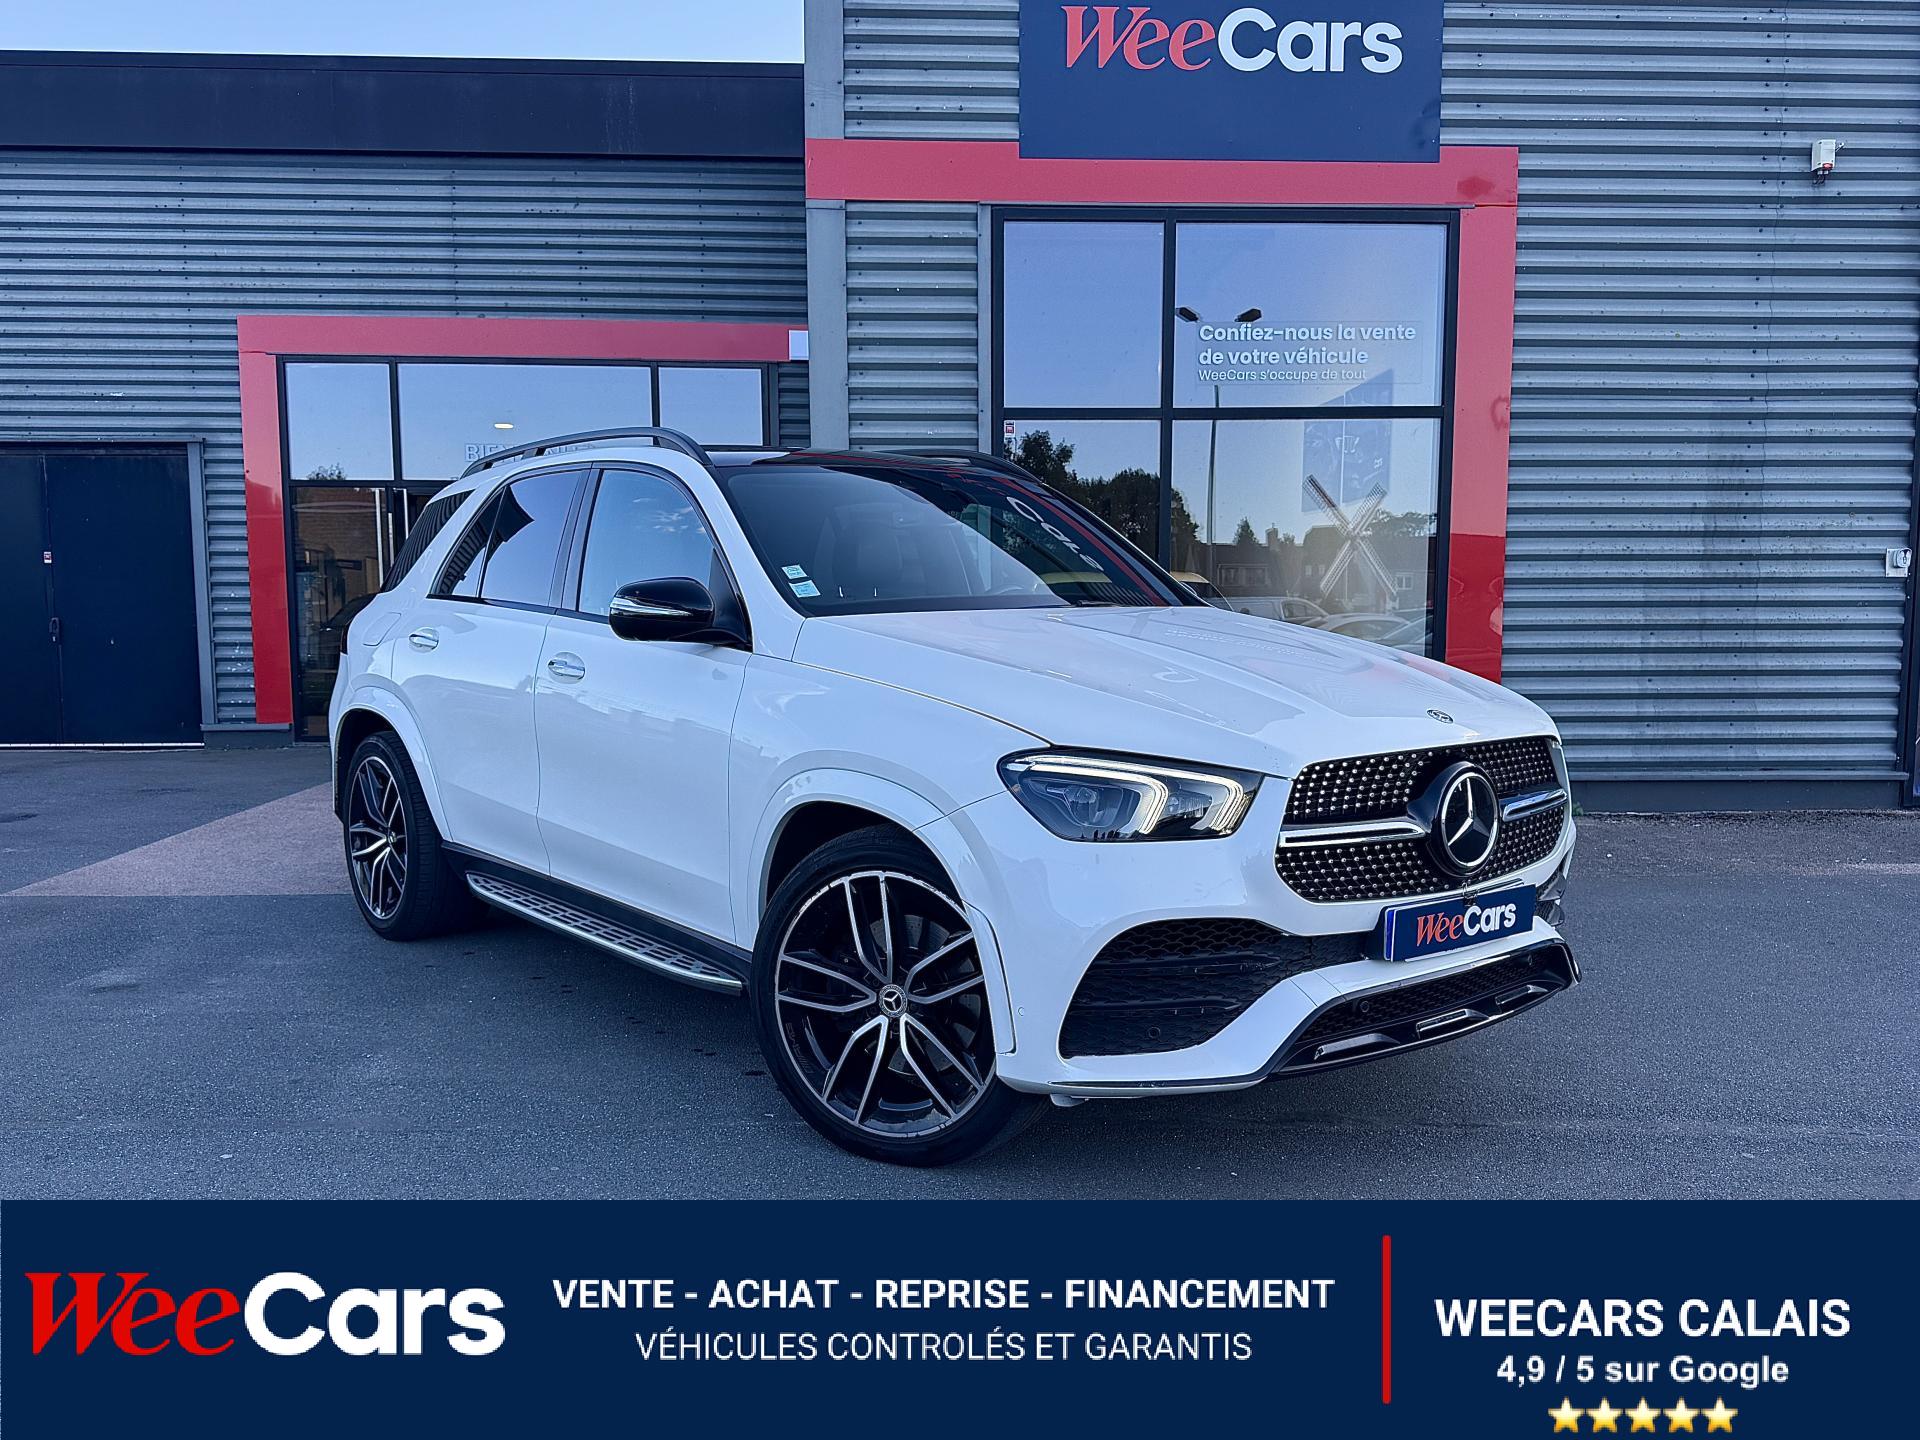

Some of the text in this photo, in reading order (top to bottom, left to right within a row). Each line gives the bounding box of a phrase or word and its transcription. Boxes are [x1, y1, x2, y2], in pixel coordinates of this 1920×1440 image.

[1061, 5, 1403, 74] WeeCars
[1199, 323, 1416, 341] Confiez-nous la vente
[1199, 347, 1369, 365] de votre véhicule
[1199, 369, 1257, 381] WeeCars
[1321, 369, 1338, 381] de
[1341, 369, 1367, 381] tout
[1416, 903, 1517, 947] WeeCars
